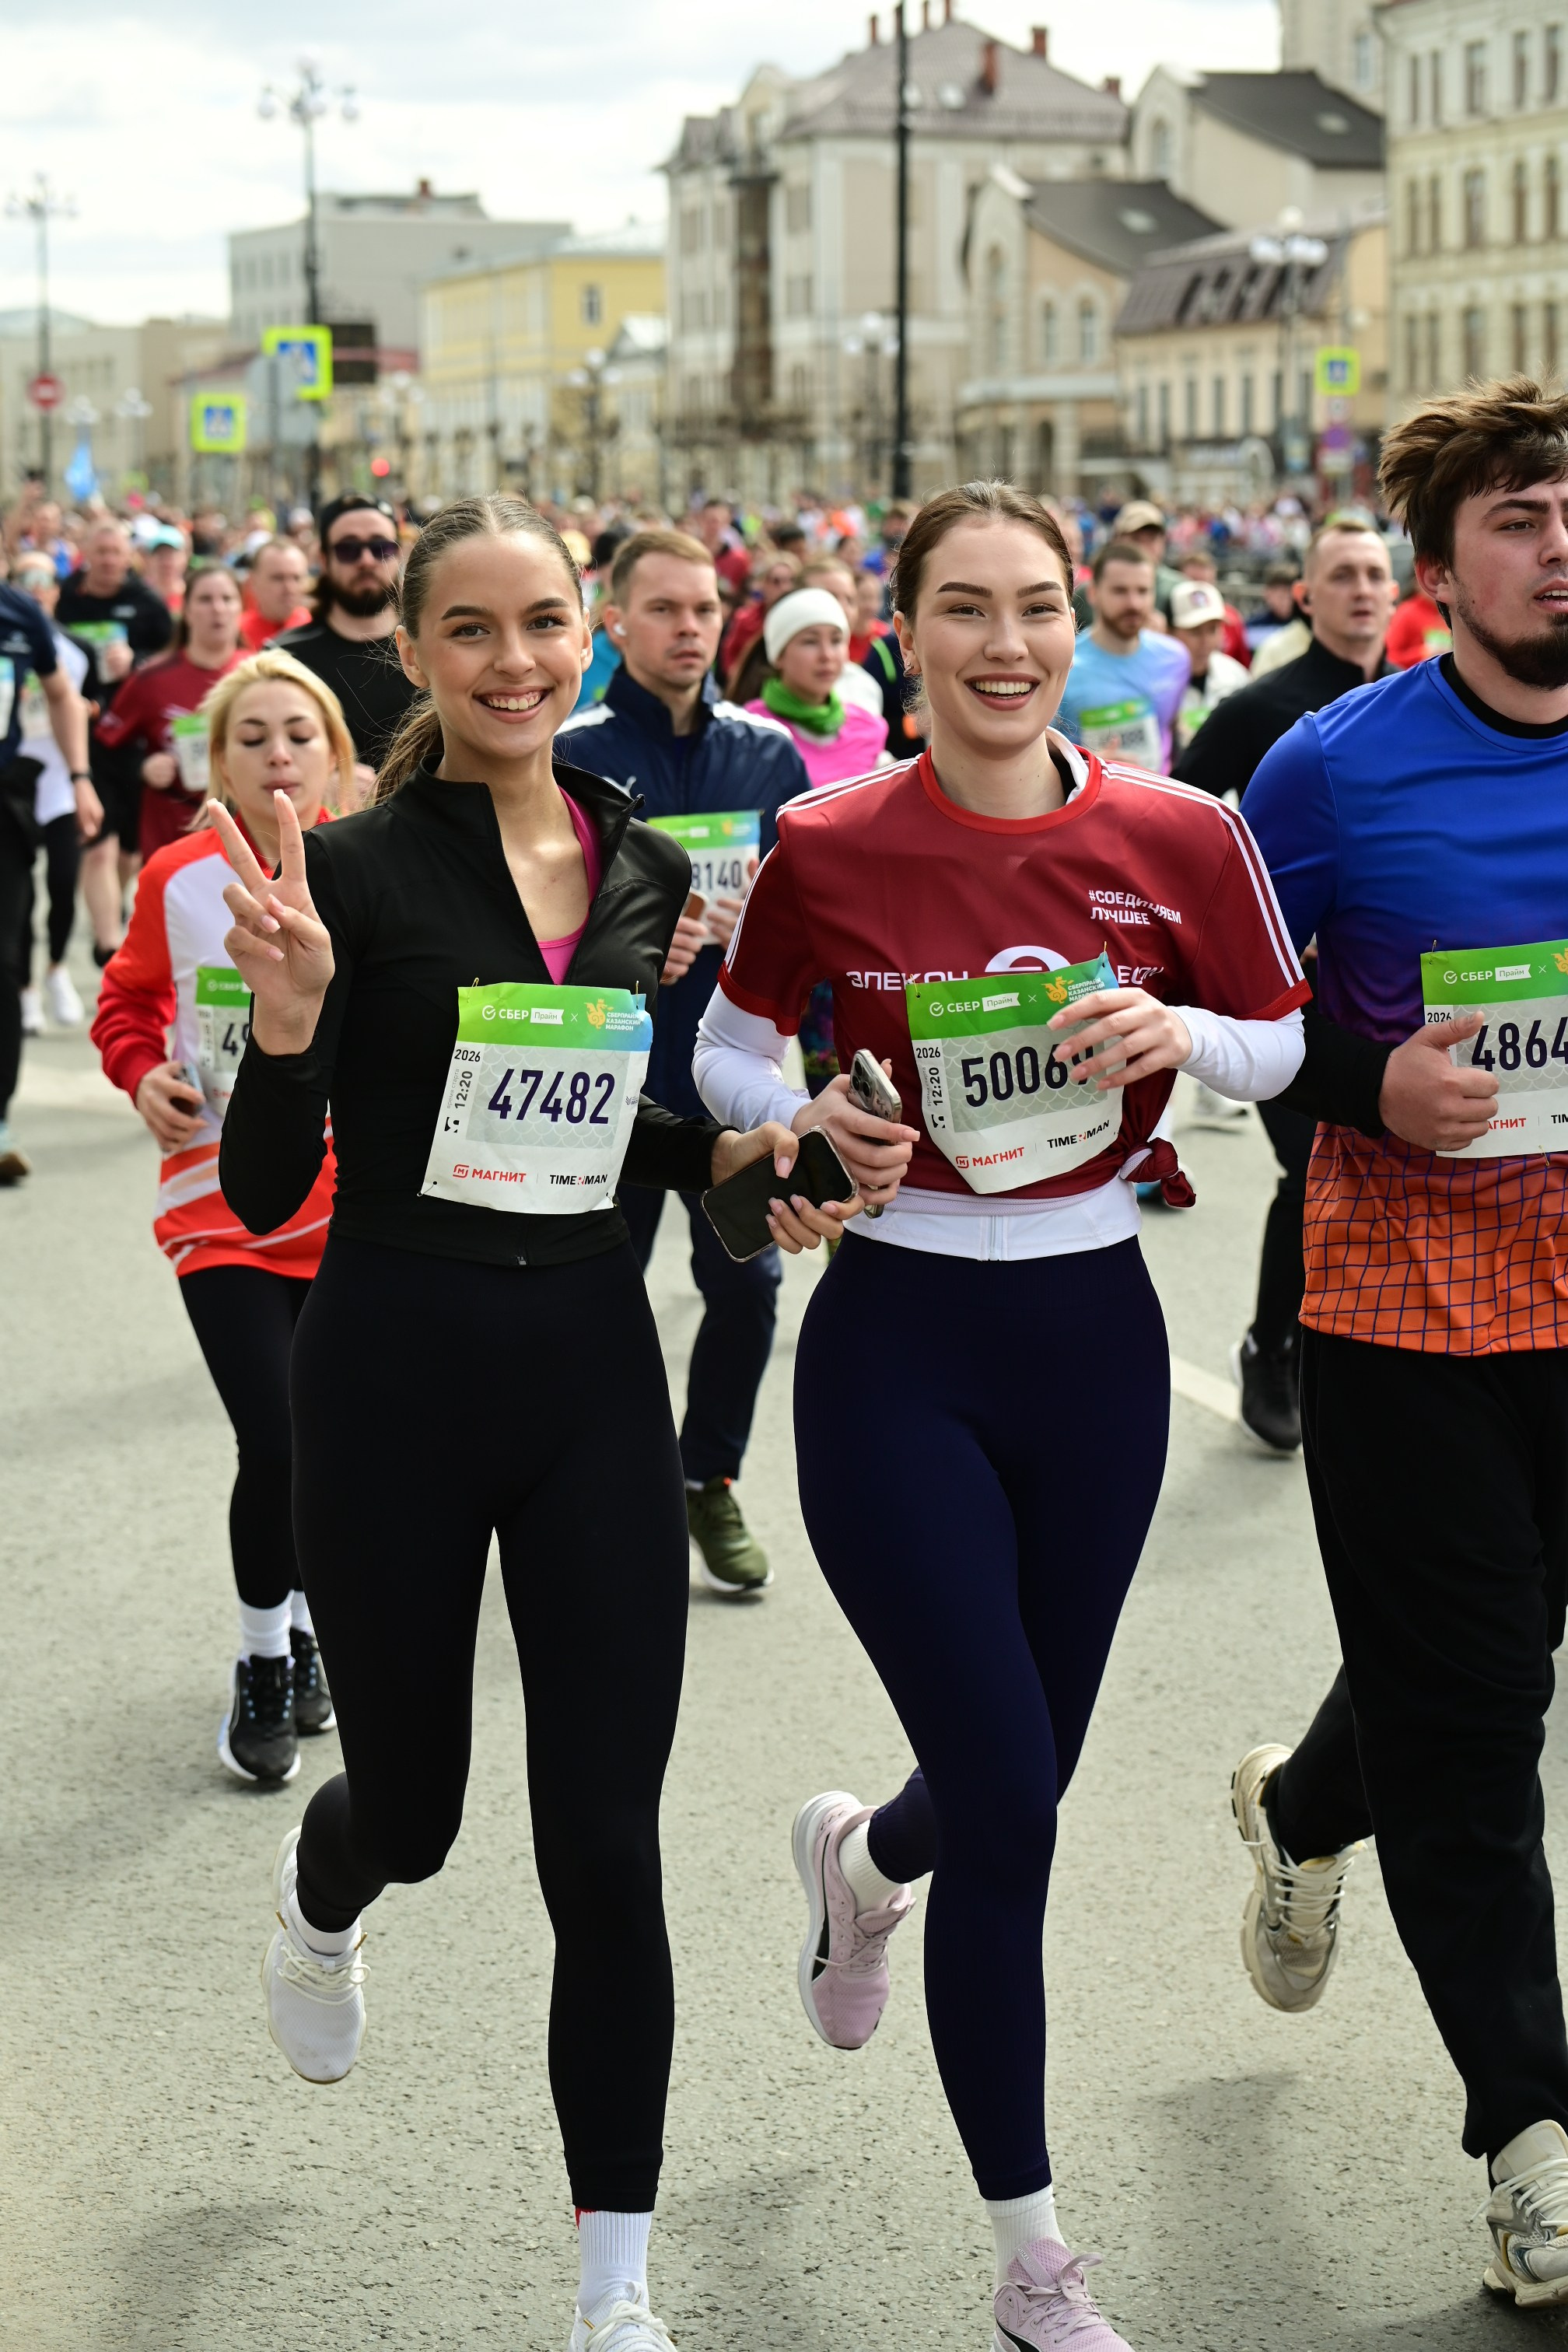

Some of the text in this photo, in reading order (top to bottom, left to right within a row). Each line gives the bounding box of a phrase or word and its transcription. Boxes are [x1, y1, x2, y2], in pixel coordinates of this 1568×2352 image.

[1090, 907, 1151, 925] ЛУЧШЕЕ
[1460, 969, 1524, 982] СБЕР Прайм
[947, 996, 1013, 1013] СБЕР Прайм
[499, 1008, 558, 1020] СБЕР Прайм
[454, 1048, 481, 1062] 2026
[916, 1047, 941, 1059] 2026
[454, 1070, 473, 1109] 12:20
[929, 1067, 943, 1106] 12:20
[488, 1068, 616, 1125] 47482
[972, 1146, 1025, 1167] МАГНИТ
[471, 1168, 527, 1183] МАГНИТ
